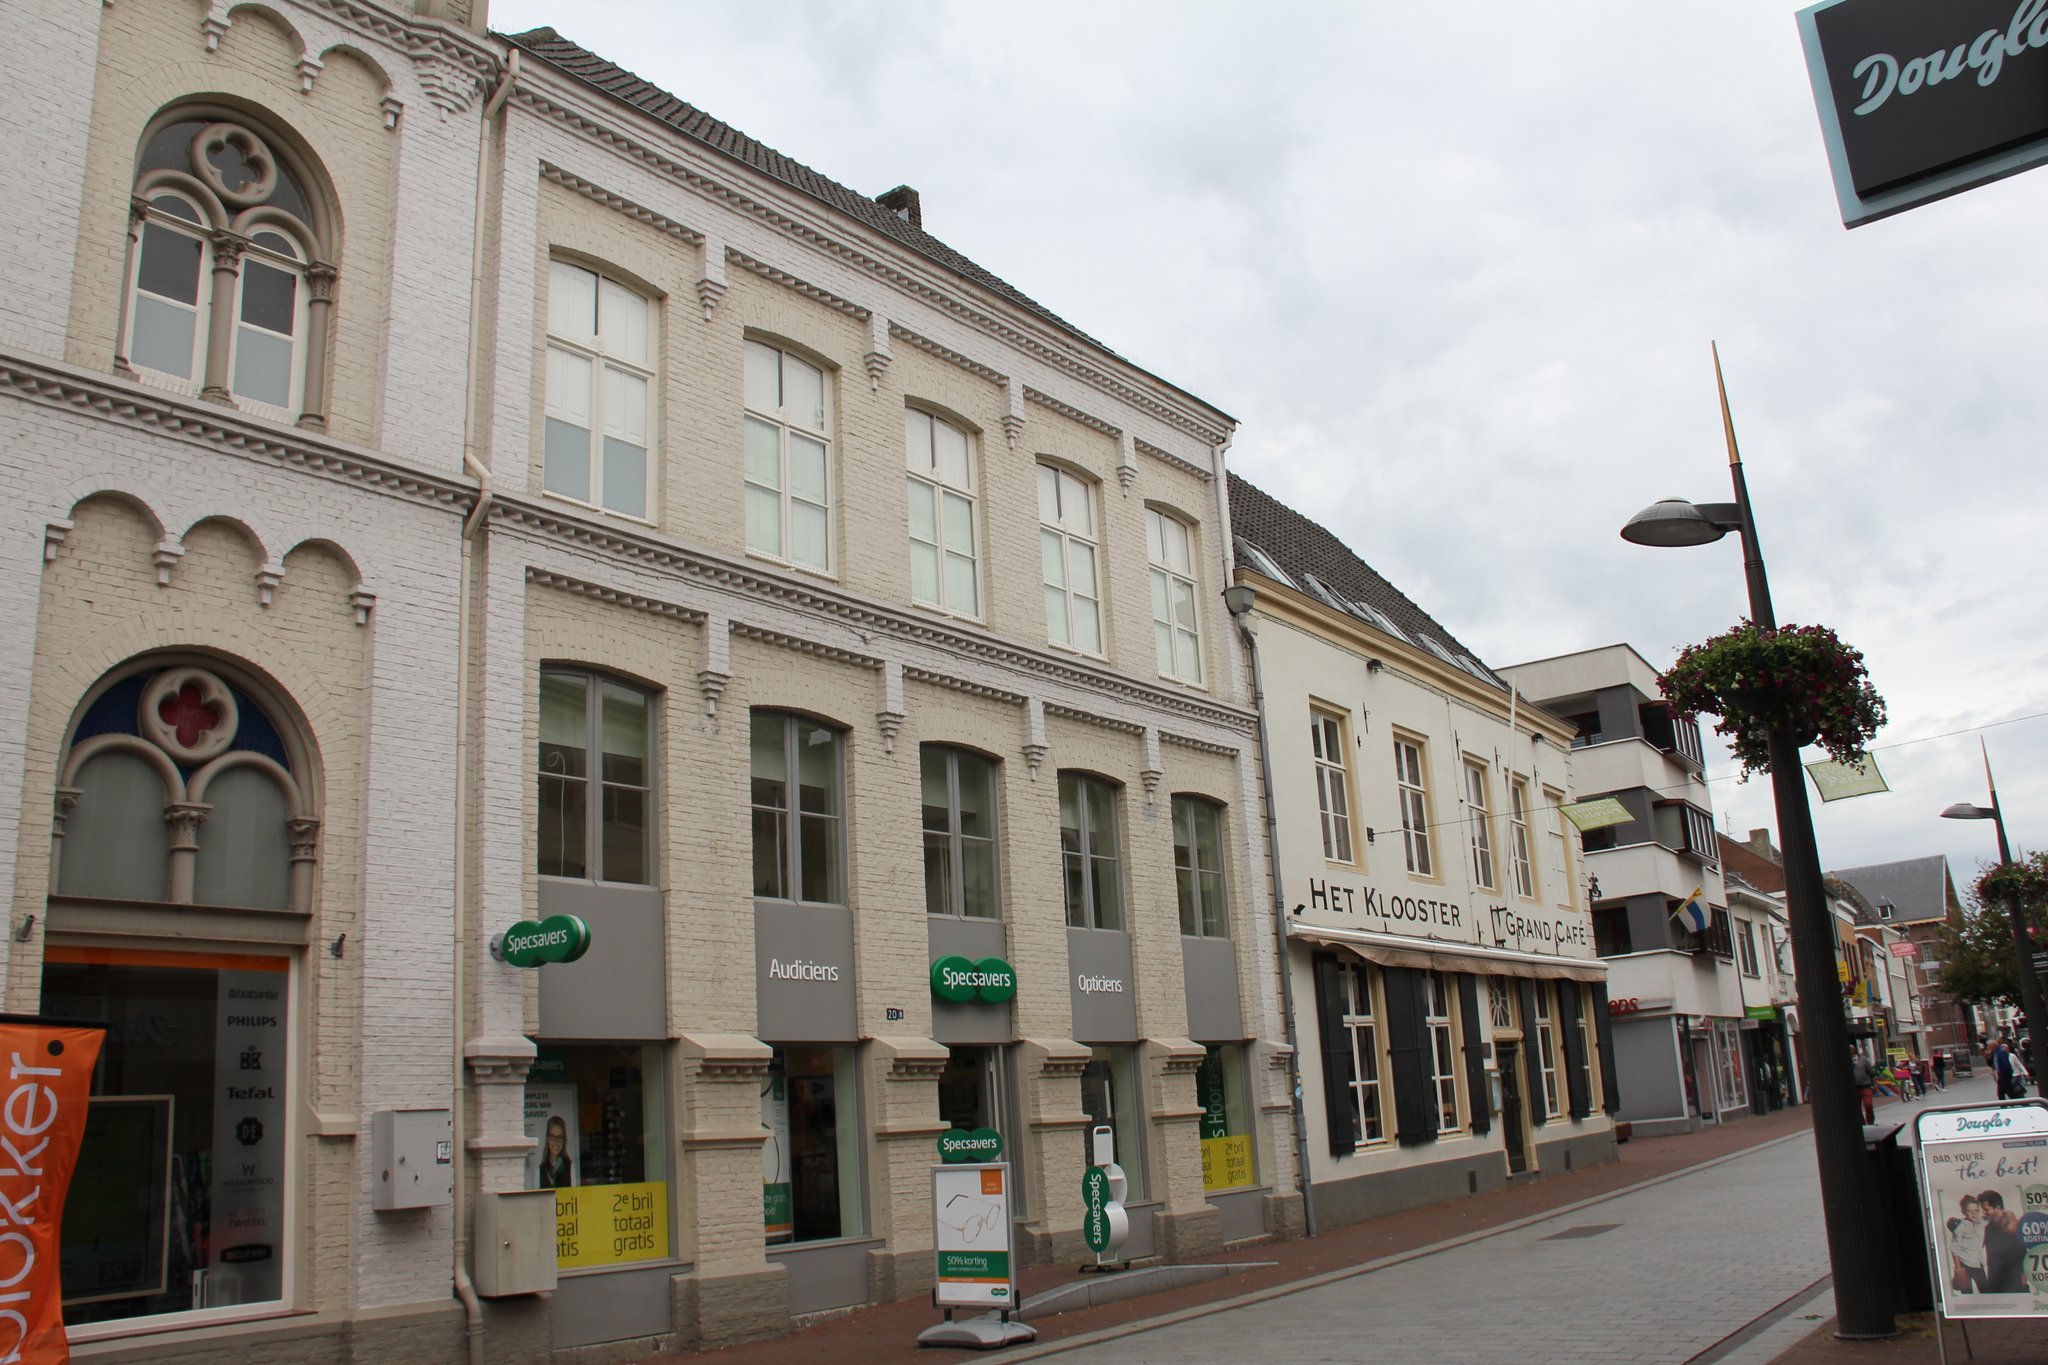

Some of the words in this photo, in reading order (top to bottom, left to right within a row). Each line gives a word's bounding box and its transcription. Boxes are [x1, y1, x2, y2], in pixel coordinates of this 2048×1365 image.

[1310, 878, 1354, 913] HET
[1363, 886, 1461, 927] KLOOSTER
[1506, 911, 1551, 941] GRAND
[1555, 920, 1586, 945] CAFÉ
[508, 927, 568, 954] Specsavers
[769, 958, 839, 982] Audiciens
[942, 967, 1011, 990] Specsavers
[1078, 974, 1123, 995] Opticiens
[227, 1015, 277, 1027] PHILIPS
[888, 1009, 897, 1019] 20
[226, 1086, 276, 1100] Tefal
[1955, 1112, 2012, 1134] Douglas
[943, 1137, 998, 1153] Specsavers
[1226, 1154, 1245, 1168] totaal
[1932, 1154, 1953, 1165] DAD,
[1954, 1152, 1985, 1163] YOU'RE
[1955, 1161, 1988, 1181] the
[1995, 1155, 2039, 1178] best!
[1227, 1167, 1247, 1184] gratis
[632, 1192, 653, 1211] bril
[1088, 1173, 1102, 1245] Specsavers
[613, 1213, 654, 1232] totaal
[613, 1232, 655, 1257] gratis
[964, 1256, 987, 1268] korting
